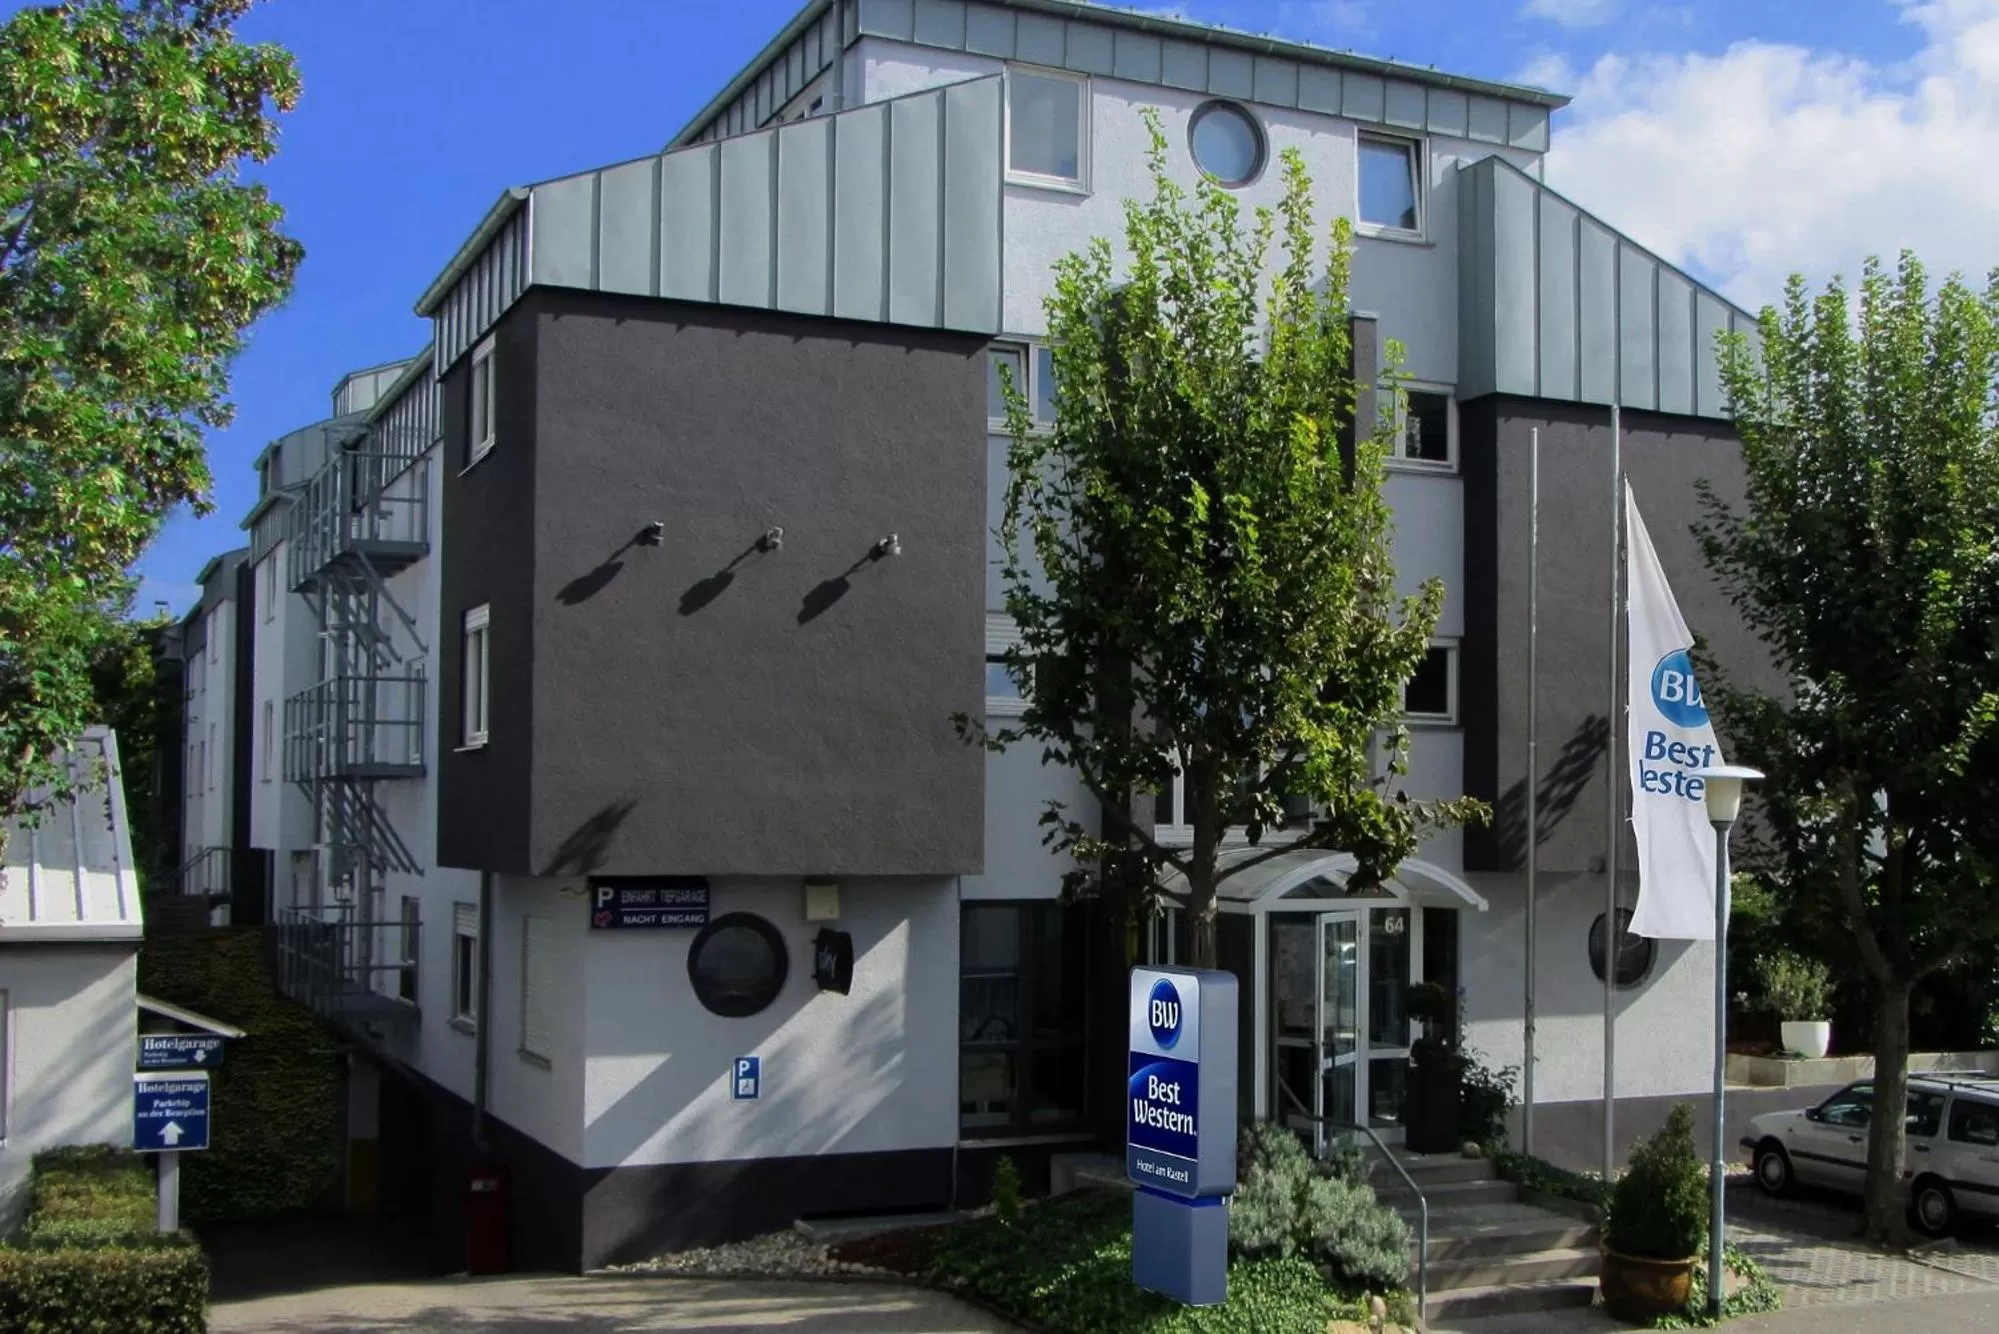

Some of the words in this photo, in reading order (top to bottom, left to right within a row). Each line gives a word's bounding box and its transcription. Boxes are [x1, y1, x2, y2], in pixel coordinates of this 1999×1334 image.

[1645, 731, 1715, 769] Best
[598, 887, 614, 908] P
[623, 914, 657, 924] NACHT
[661, 914, 705, 924] EINGANG
[1385, 916, 1404, 933] 64
[1152, 999, 1178, 1029] BW
[144, 1037, 220, 1052] Hotelgarage
[739, 1060, 750, 1077] P
[138, 1082, 206, 1095] Hotelgarage
[1148, 1074, 1180, 1105] Best
[1136, 1158, 1155, 1174] Hotel
[1155, 1165, 1167, 1177] am
